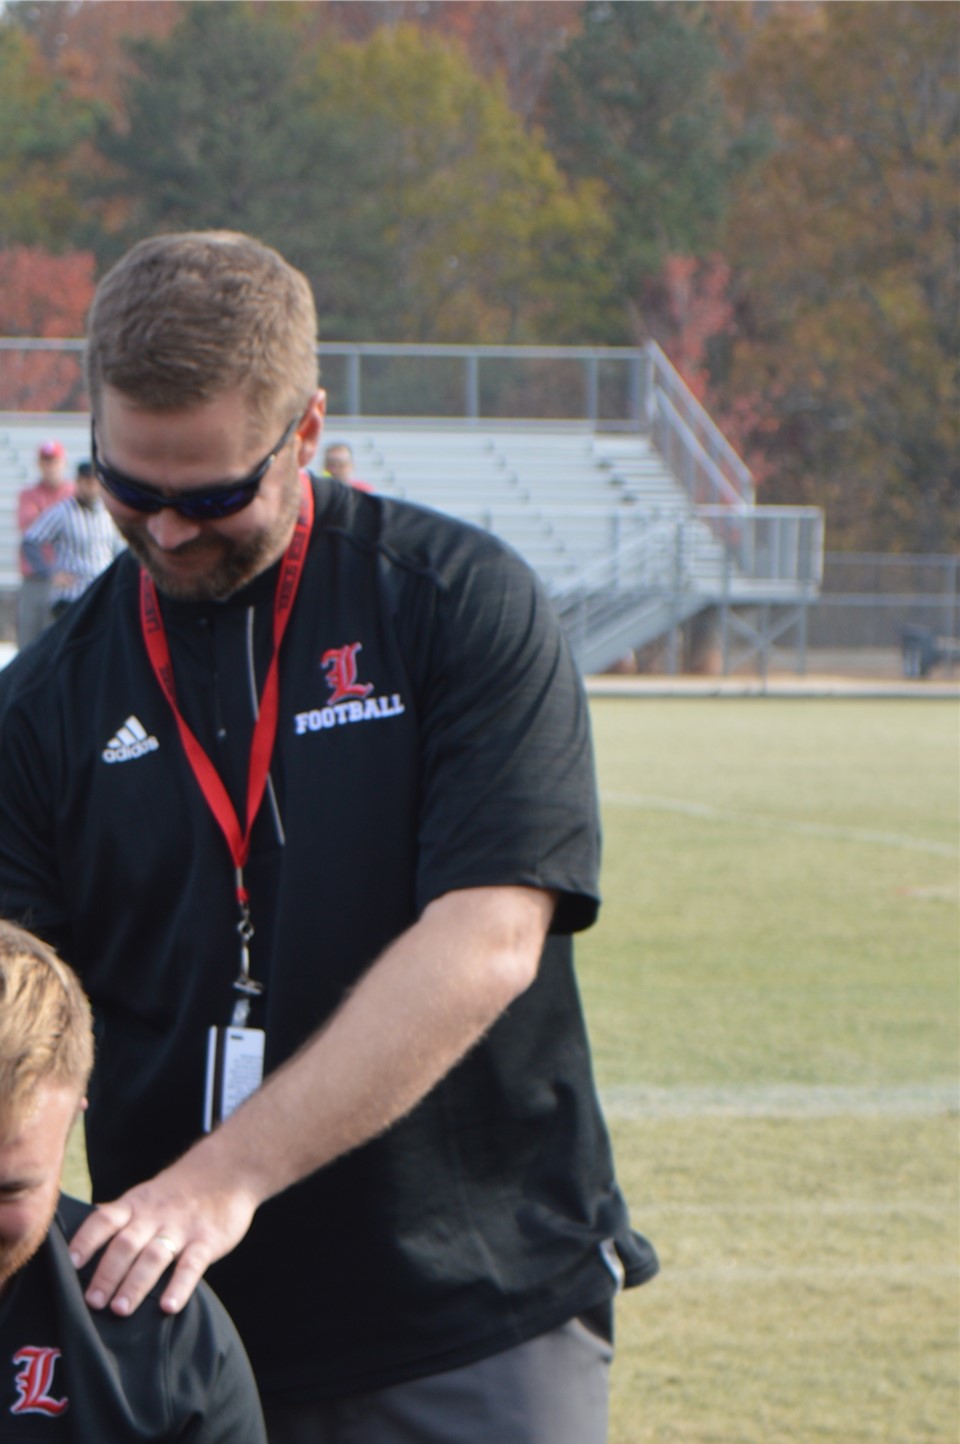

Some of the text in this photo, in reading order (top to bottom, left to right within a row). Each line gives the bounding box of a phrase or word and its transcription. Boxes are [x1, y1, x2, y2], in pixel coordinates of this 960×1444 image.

[320, 641, 374, 706] L
[294, 693, 405, 736] FOOTBALL
[102, 735, 160, 764] adidas
[9, 1345, 69, 1417] L
